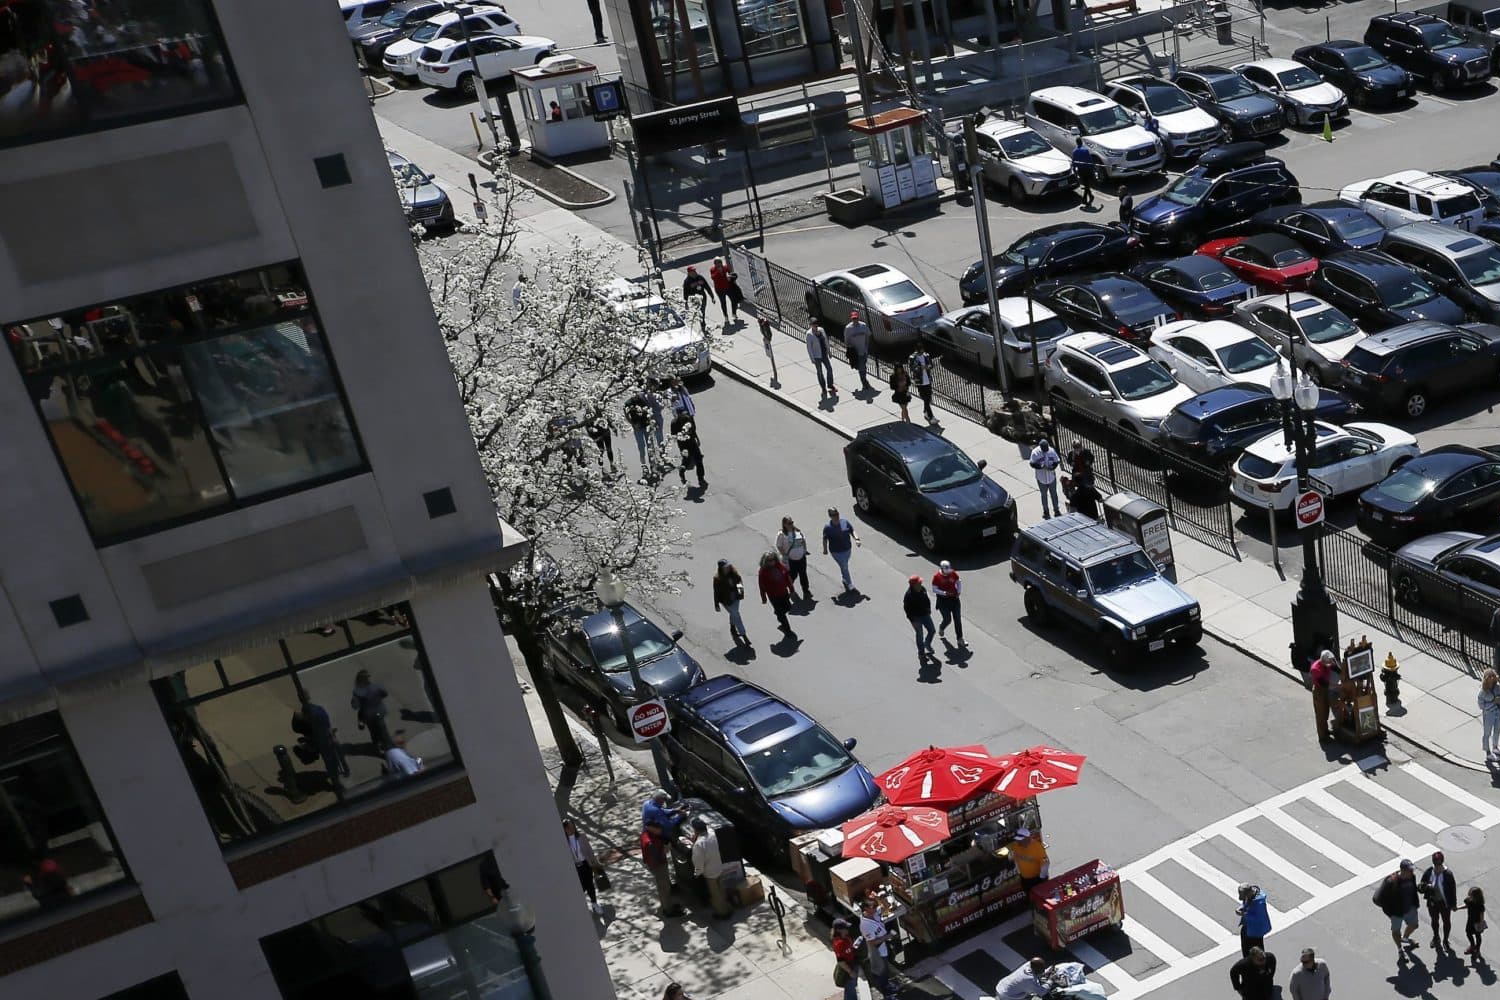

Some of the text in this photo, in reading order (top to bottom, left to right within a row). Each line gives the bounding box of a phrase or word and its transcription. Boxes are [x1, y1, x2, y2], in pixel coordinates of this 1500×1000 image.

[601, 89, 611, 106] P
[669, 109, 720, 126] 55 Jersey Street
[1302, 509, 1318, 519] ENTER
[1144, 521, 1166, 537] FREE
[634, 707, 660, 720] DO NOT
[640, 720, 662, 734] ENTER
[951, 803, 1011, 834] EEF HOT DOGS
[949, 884, 978, 906] Sweet
[981, 876, 992, 890] &
[944, 891, 1027, 932] ALL BEEF HOT DOGS
[1068, 919, 1110, 941] ALL BEEF HOT DOGS
